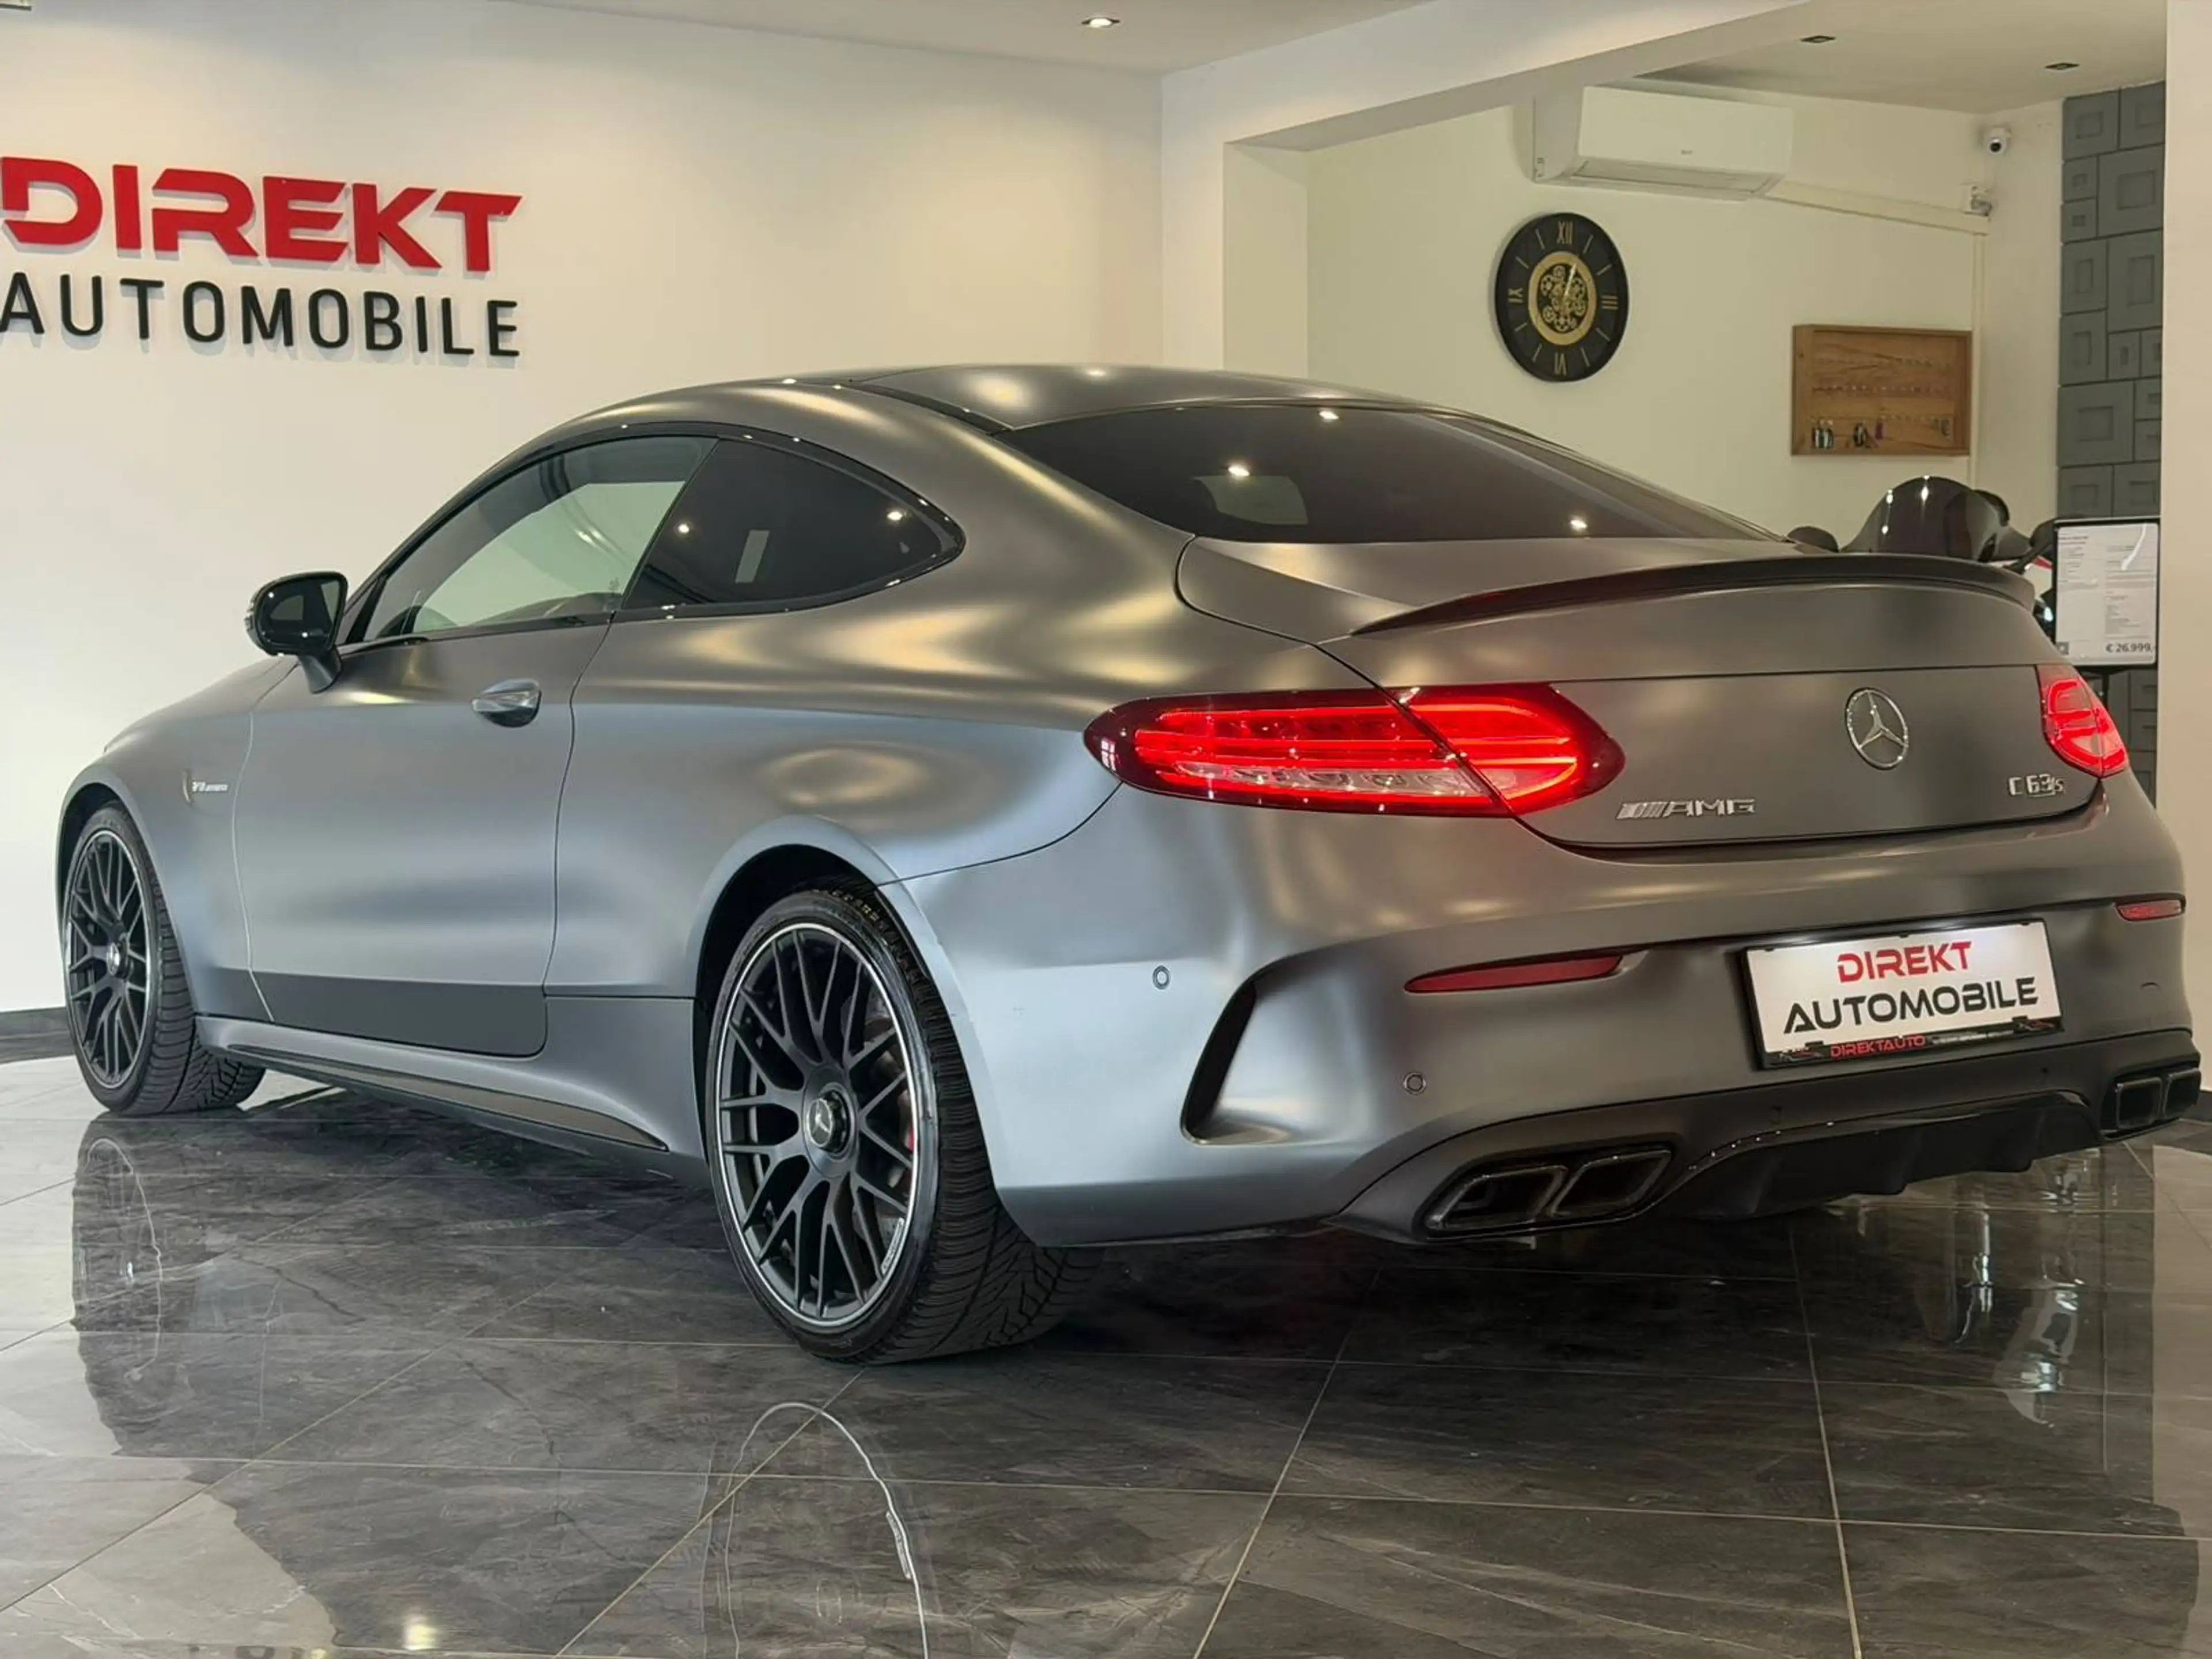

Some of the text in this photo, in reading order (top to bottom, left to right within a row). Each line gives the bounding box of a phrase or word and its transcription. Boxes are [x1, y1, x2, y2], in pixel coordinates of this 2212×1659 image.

[0, 157, 522, 272] DIREKT
[0, 271, 520, 357] AUTOMOBILE
[1662, 798, 1755, 818] AMG
[1837, 941, 1971, 983] DIREKT
[1783, 976, 2039, 1034] AUTOMOBILE
[1830, 1035, 1926, 1059] DIREKTAUTO
